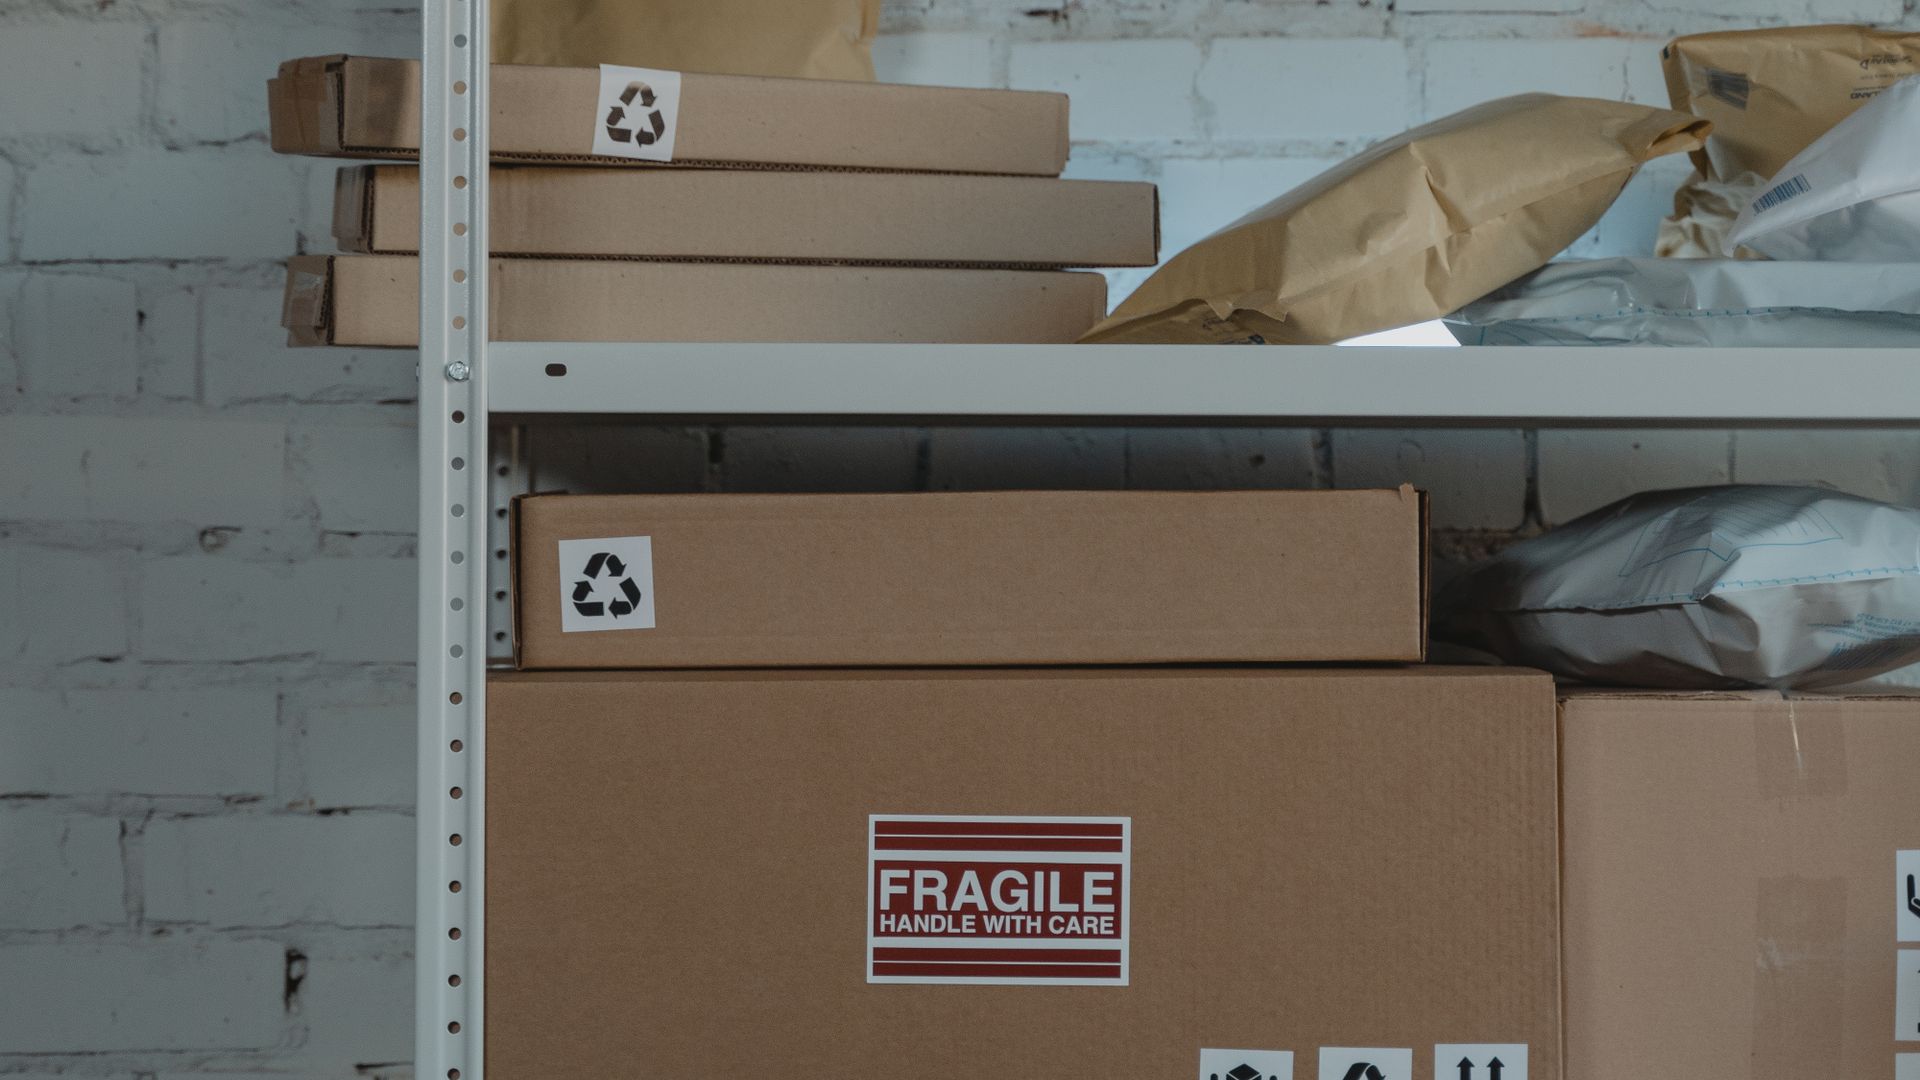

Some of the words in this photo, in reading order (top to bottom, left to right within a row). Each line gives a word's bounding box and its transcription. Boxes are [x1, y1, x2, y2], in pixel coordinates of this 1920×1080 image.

[880, 869, 1115, 913] FRAGILE
[880, 914, 976, 933] HANDLE
[983, 915, 1041, 934] WITH
[1048, 916, 1114, 935] CARE
